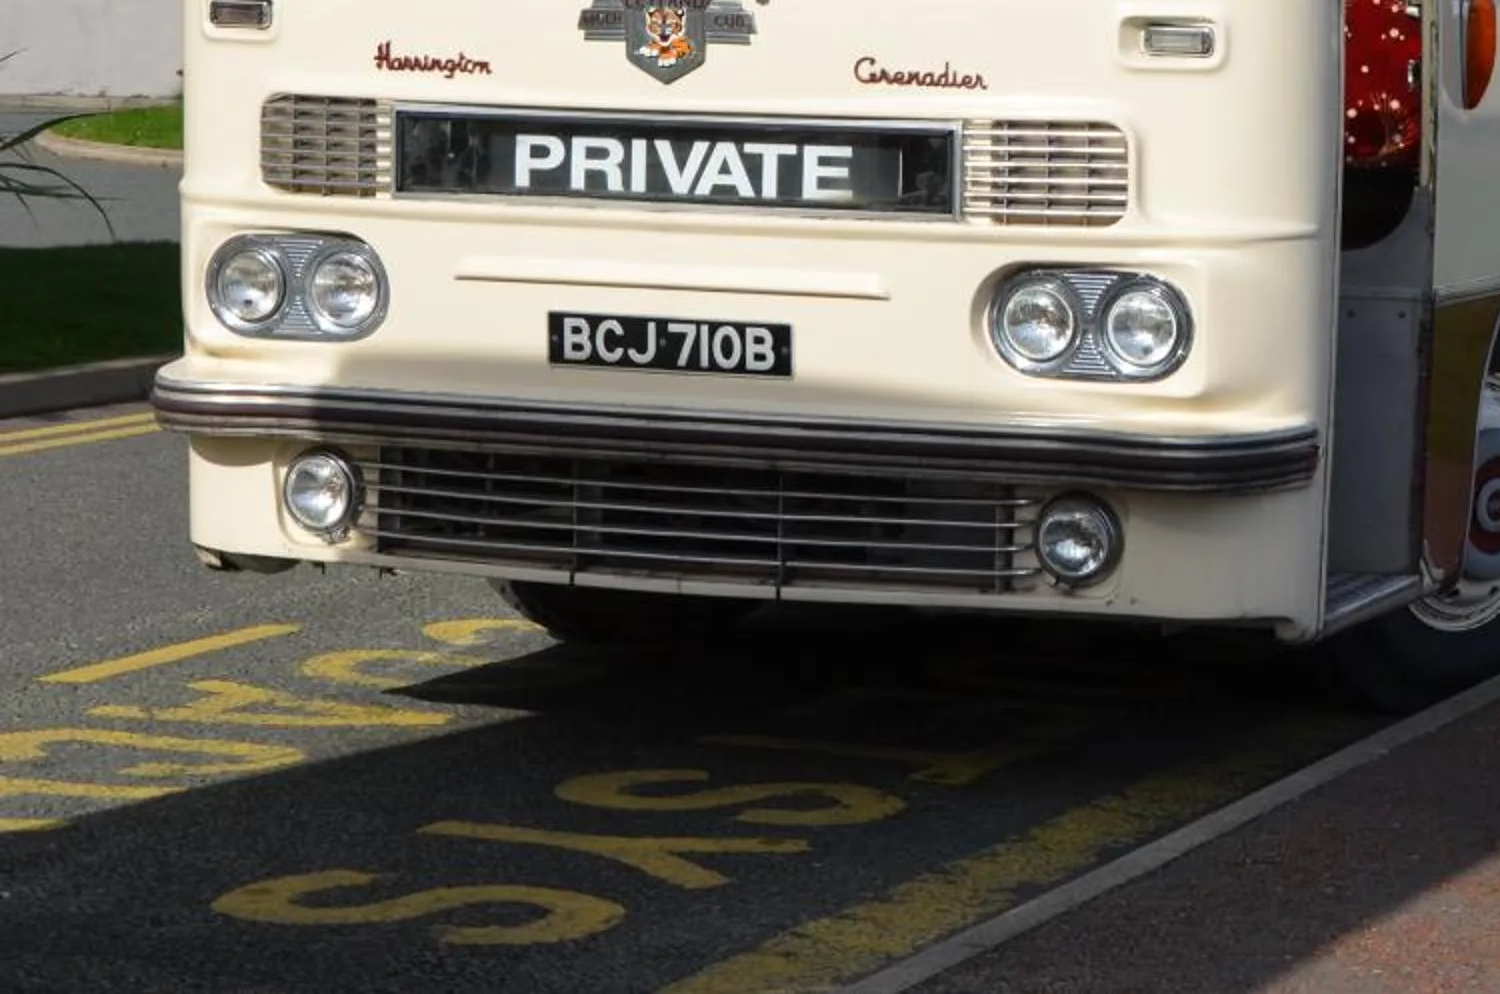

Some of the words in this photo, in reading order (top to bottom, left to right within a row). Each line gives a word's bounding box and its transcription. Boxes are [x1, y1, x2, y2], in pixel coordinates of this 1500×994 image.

[374, 41, 493, 79] Harrington
[853, 56, 989, 92] Grenadier
[514, 133, 855, 202] PRIVATE
[562, 317, 659, 370] BCJ
[667, 323, 778, 375] 710B
